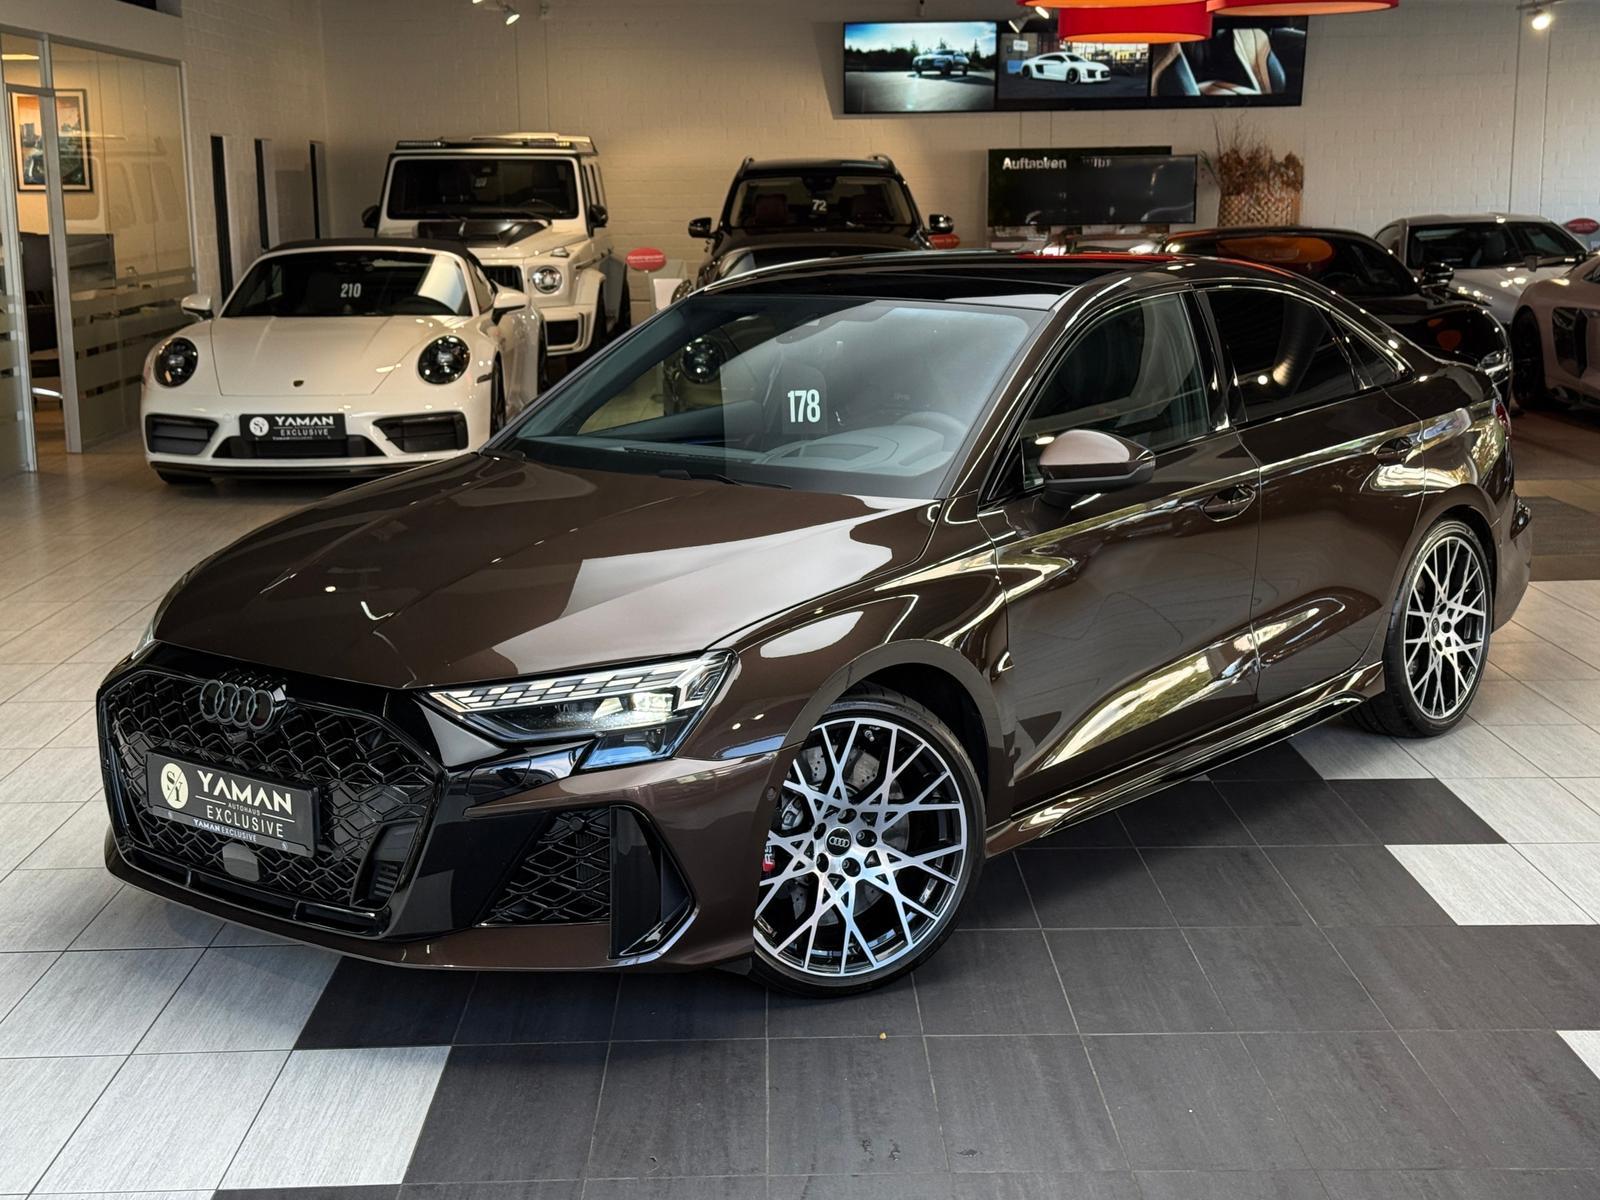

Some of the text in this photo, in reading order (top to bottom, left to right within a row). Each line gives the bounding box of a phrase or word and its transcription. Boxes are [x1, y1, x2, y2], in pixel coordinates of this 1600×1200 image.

[812, 199, 826, 211] 72
[340, 282, 362, 298] 210
[787, 389, 821, 423] 178
[274, 416, 334, 426] YAMAN
[280, 428, 329, 436] EXCLUSIVE
[197, 769, 293, 816] YAMAN
[227, 802, 261, 817] AUTOHAUS
[206, 805, 284, 838] EXCLUSIVE
[193, 818, 257, 842] YAMAN EXCLUSIVE
